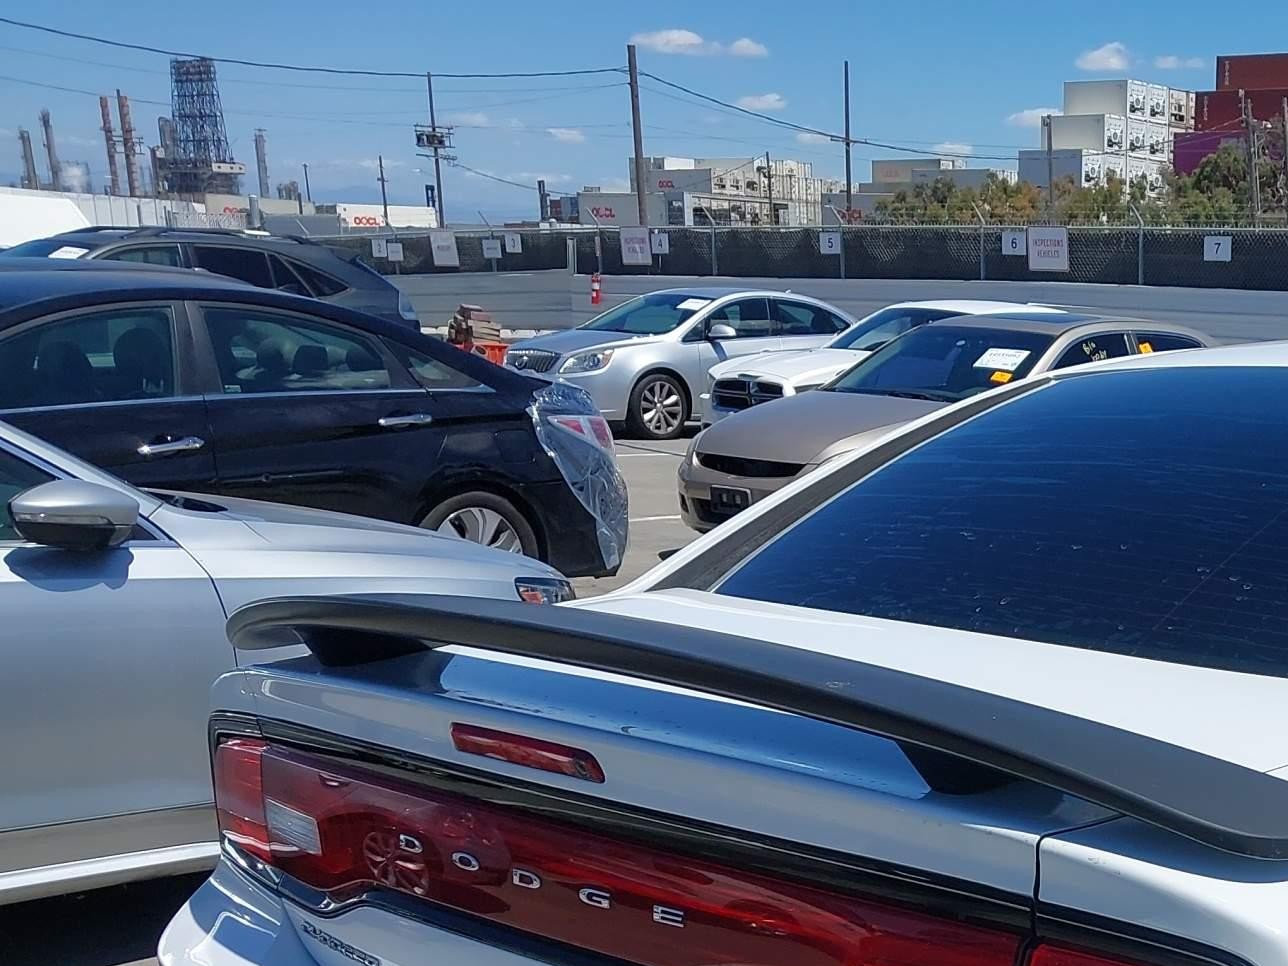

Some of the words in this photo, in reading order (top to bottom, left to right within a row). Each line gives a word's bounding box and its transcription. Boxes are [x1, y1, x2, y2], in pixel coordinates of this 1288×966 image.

[354, 216, 380, 225] OOCL
[657, 239, 663, 249] 4
[827, 237, 834, 249] 5
[1011, 237, 1018, 249] 6
[1214, 242, 1221, 255] 7
[400, 834, 684, 928] DODGE
